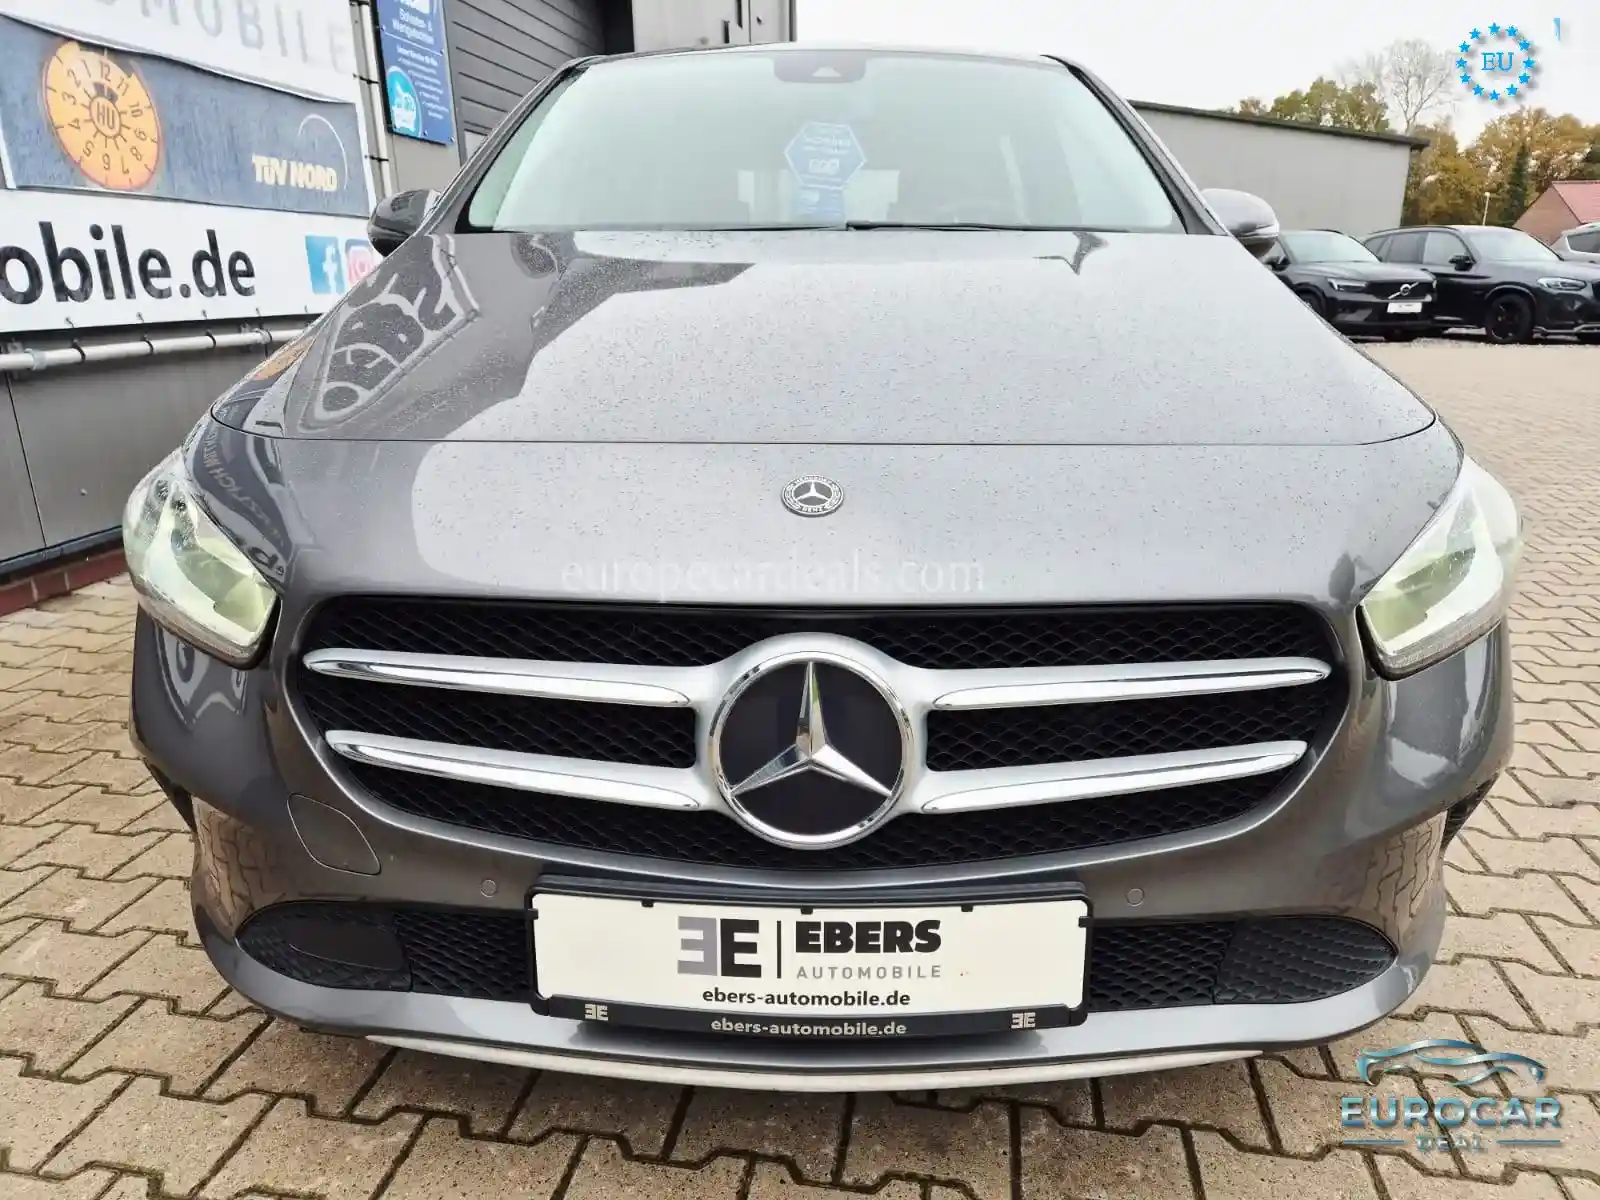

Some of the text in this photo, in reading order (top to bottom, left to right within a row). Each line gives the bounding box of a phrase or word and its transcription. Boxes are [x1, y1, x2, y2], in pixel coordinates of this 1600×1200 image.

[96, 102, 116, 131] HU
[289, 160, 338, 192] NORD
[0, 220, 256, 305] obile.de
[795, 919, 942, 954] EBERS
[796, 964, 942, 980] AUTOMOBILE
[702, 987, 911, 1006] ebers-automobile.de
[710, 1017, 907, 1036] ebers-automobile.de
